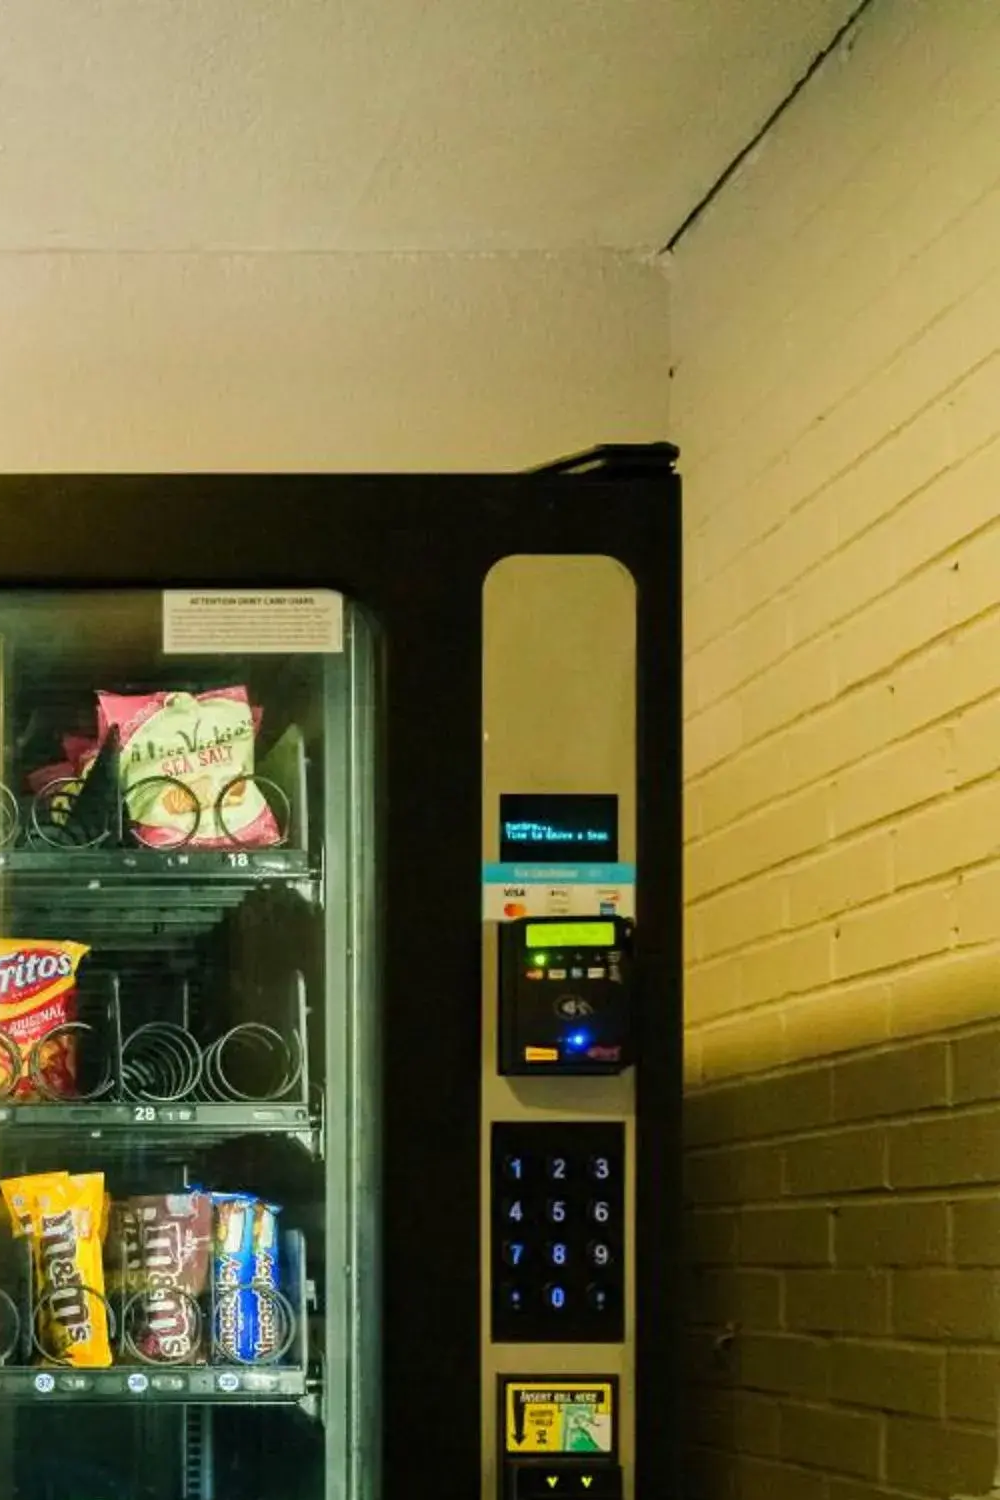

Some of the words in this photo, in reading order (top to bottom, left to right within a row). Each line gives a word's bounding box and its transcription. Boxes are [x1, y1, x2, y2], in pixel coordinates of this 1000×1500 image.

[161, 754, 194, 778] SEA
[198, 744, 233, 768] SALT
[228, 853, 249, 867] 18
[134, 1107, 156, 1121] 28
[511, 1158, 522, 1179] 1
[553, 1158, 566, 1179] 2
[595, 1158, 609, 1179] 3
[509, 1201, 523, 1221] 4
[553, 1201, 565, 1222] 5
[594, 1201, 609, 1222] 6
[510, 1244, 523, 1264] 7
[553, 1243, 565, 1265] 8
[594, 1244, 609, 1265] 9
[552, 1287, 565, 1308] 0
[38, 1376, 53, 1389] 37
